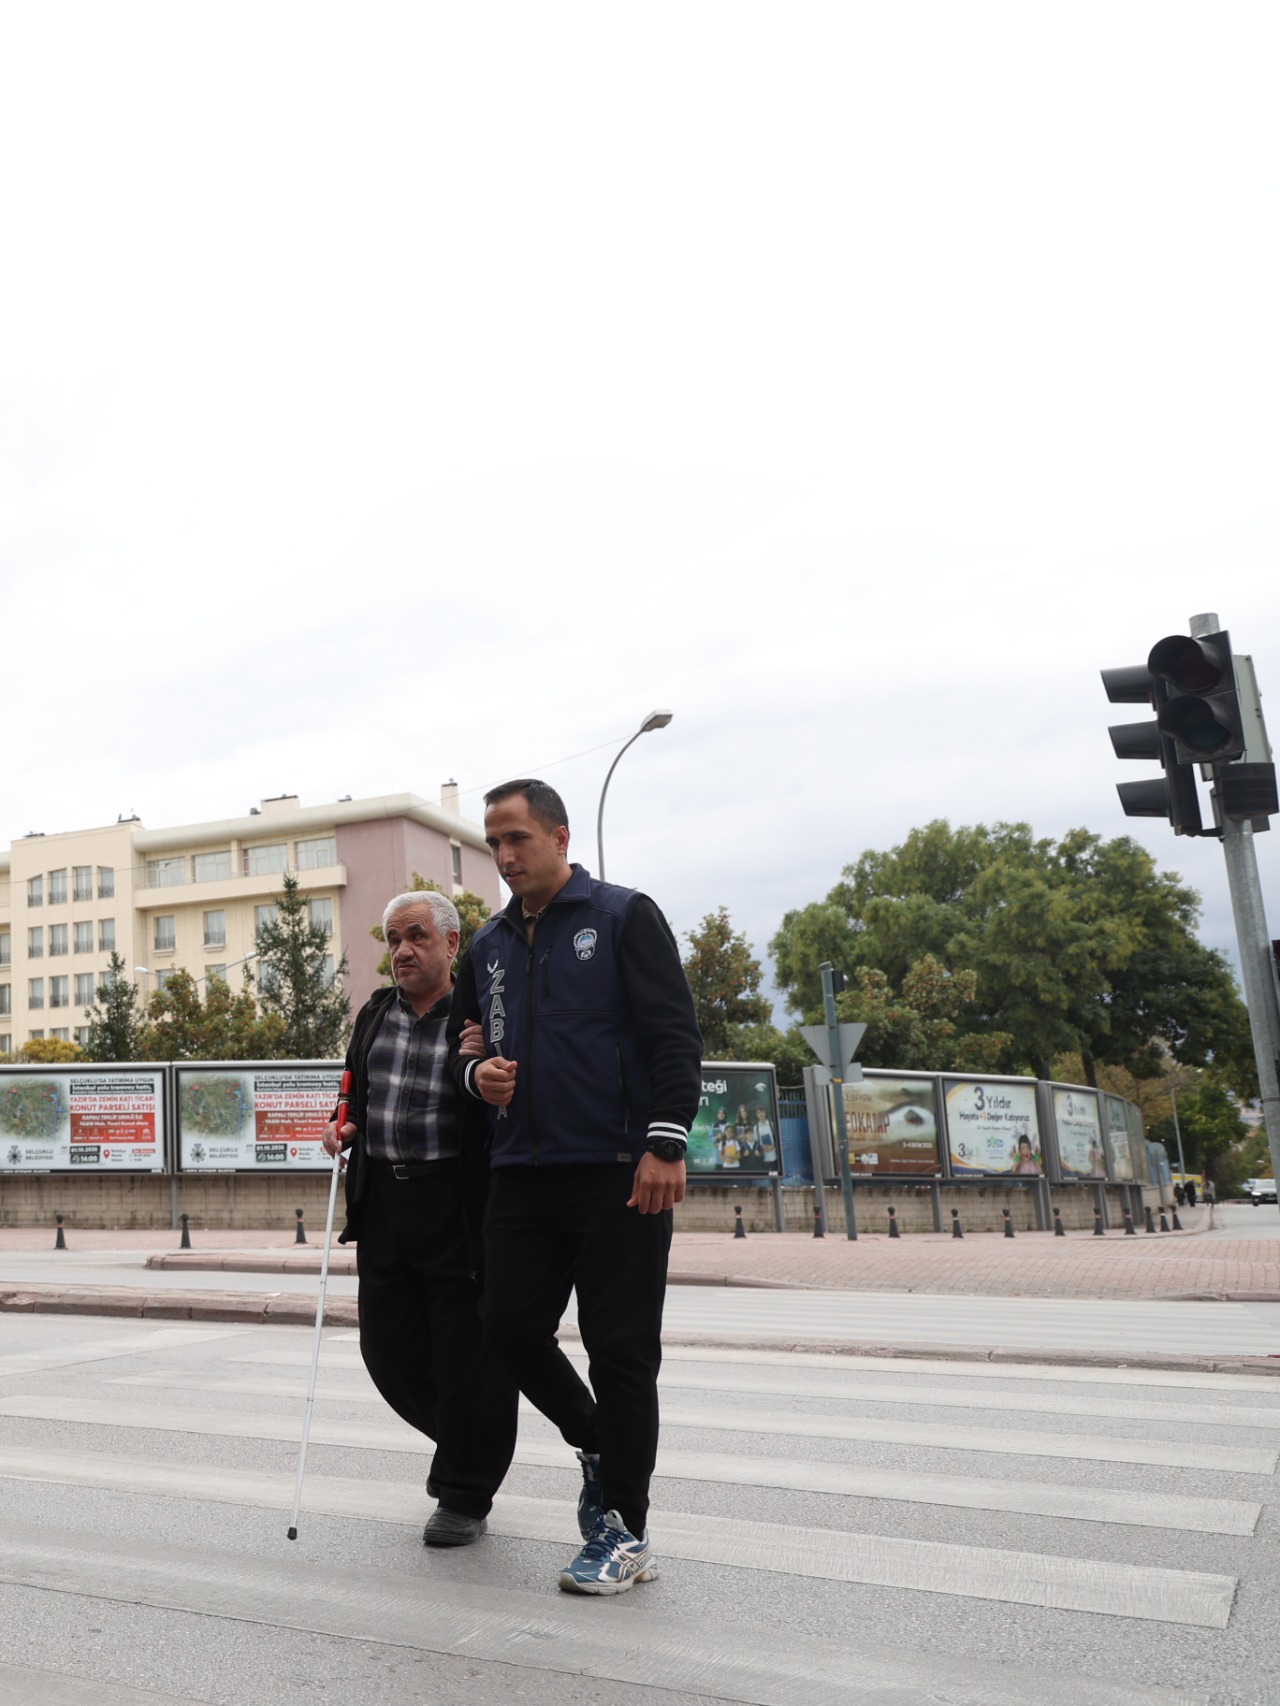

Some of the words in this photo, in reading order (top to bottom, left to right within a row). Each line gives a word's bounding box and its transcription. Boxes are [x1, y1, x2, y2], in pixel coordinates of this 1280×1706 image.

[489, 969, 507, 1120] ZABIA
[701, 1080, 727, 1094] teği
[285, 1100, 317, 1108] PARSELİ
[974, 1086, 985, 1110] 3
[986, 1096, 1011, 1109] Yıldır
[99, 1103, 129, 1111] PARSELİ
[132, 1104, 155, 1112] SATIŞI
[845, 1112, 890, 1134] EOKAMP
[959, 1111, 979, 1122] Hayata
[987, 1113, 1003, 1122] Değer
